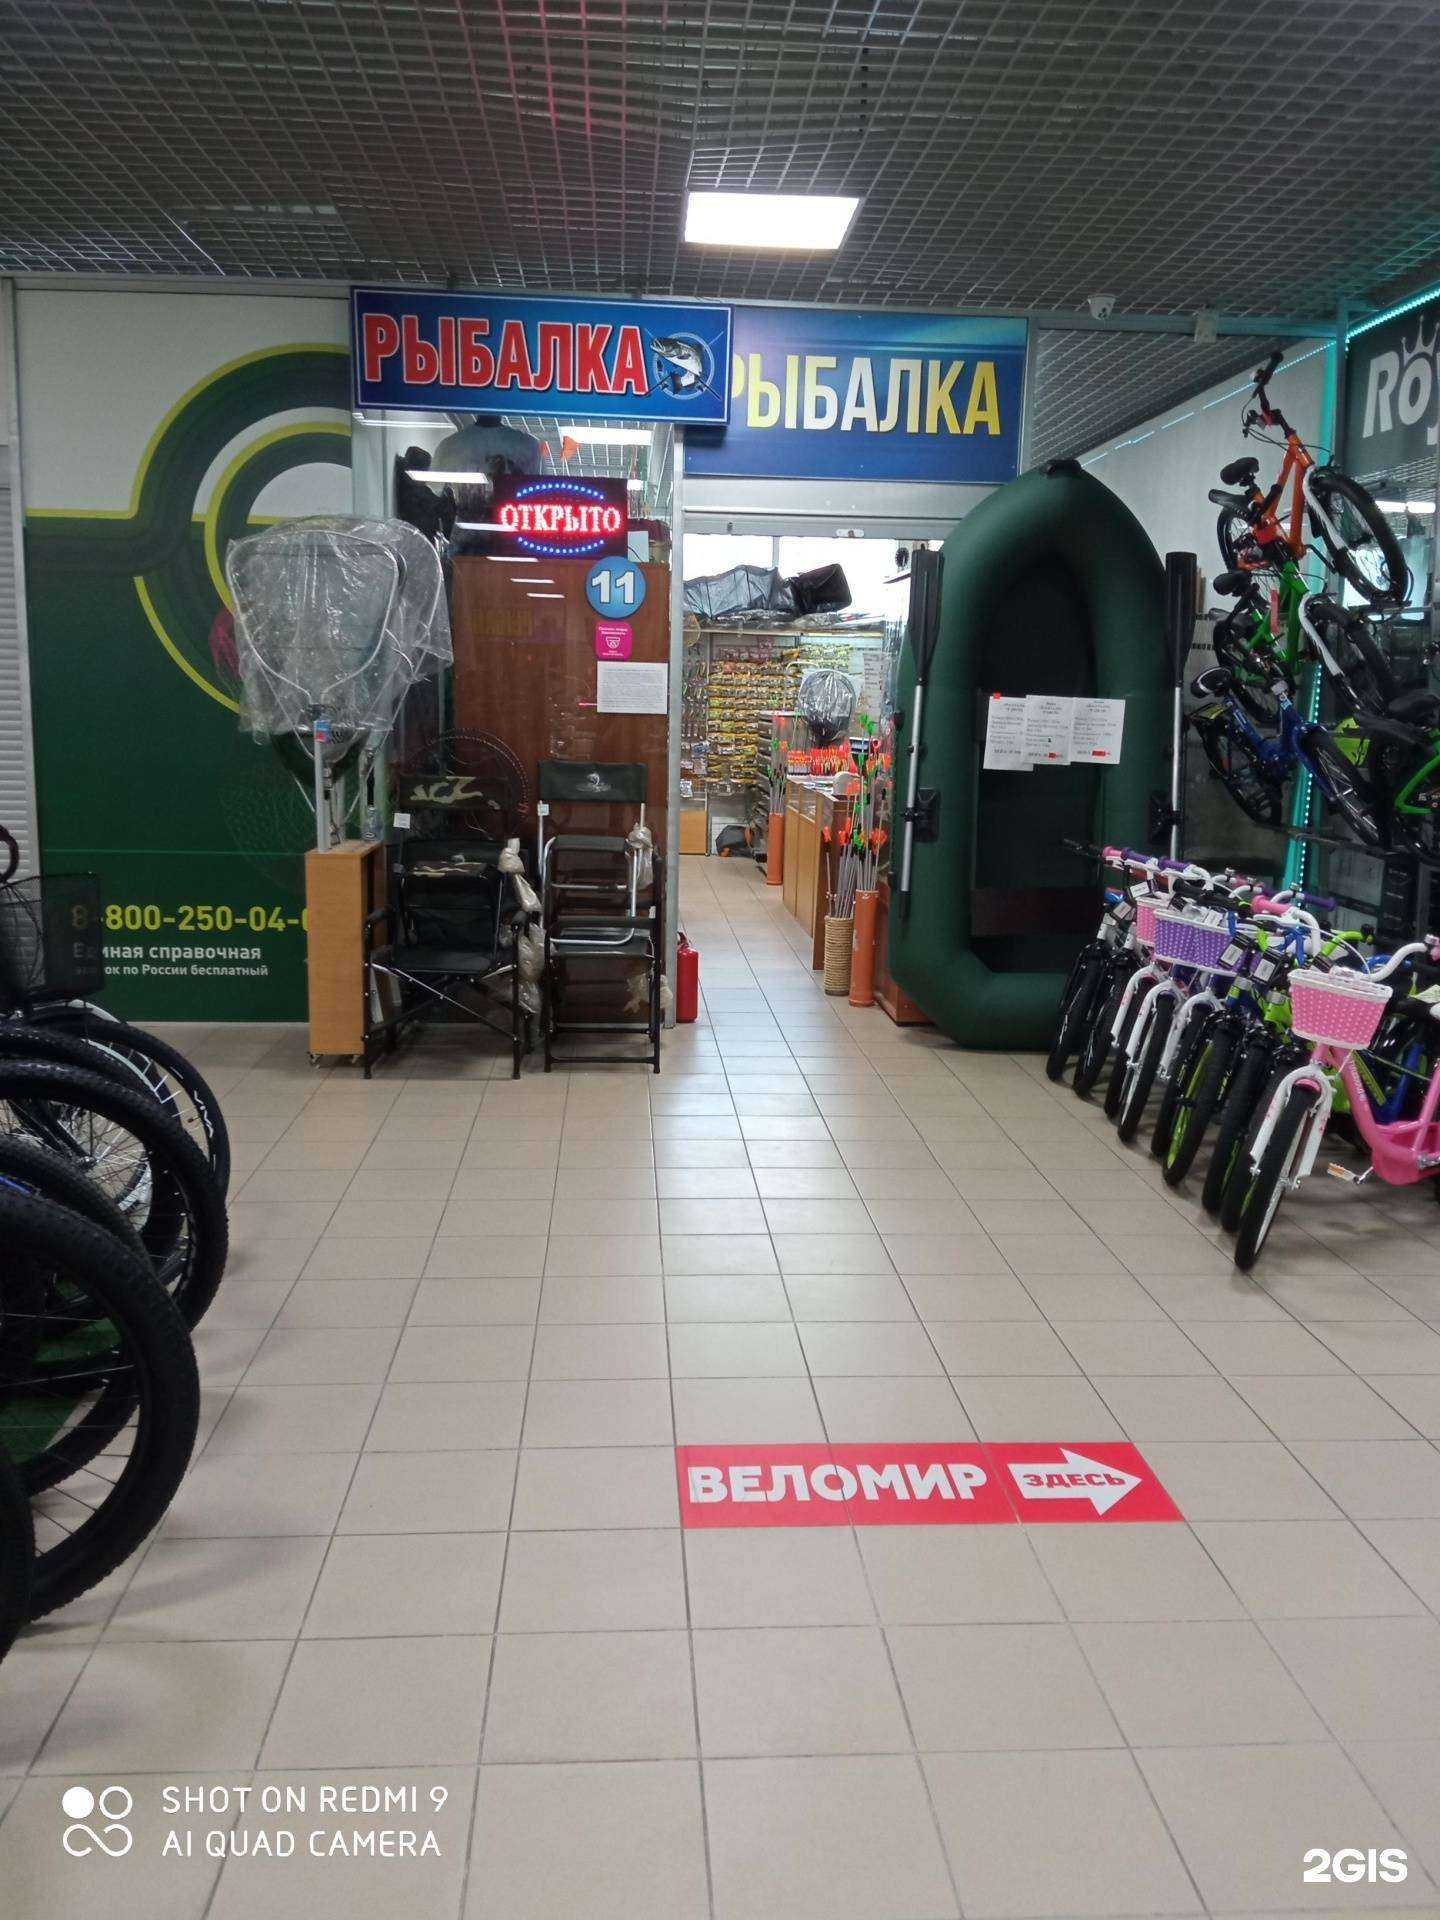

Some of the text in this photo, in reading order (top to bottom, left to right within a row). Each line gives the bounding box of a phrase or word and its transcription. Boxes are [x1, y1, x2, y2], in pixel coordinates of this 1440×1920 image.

[362, 312, 649, 396] РЫБАЛКА
[1362, 350, 1440, 446] RO
[500, 503, 622, 532] ОТКРЫТО
[591, 570, 635, 605] 11
[149, 945, 262, 962] справочная
[123, 966, 139, 977] по
[142, 964, 187, 976] России
[190, 964, 269, 977] бесплатный
[687, 1462, 988, 1503] ВЕЛОМИР
[1023, 1472, 1126, 1488] ЗДЕСЬ
